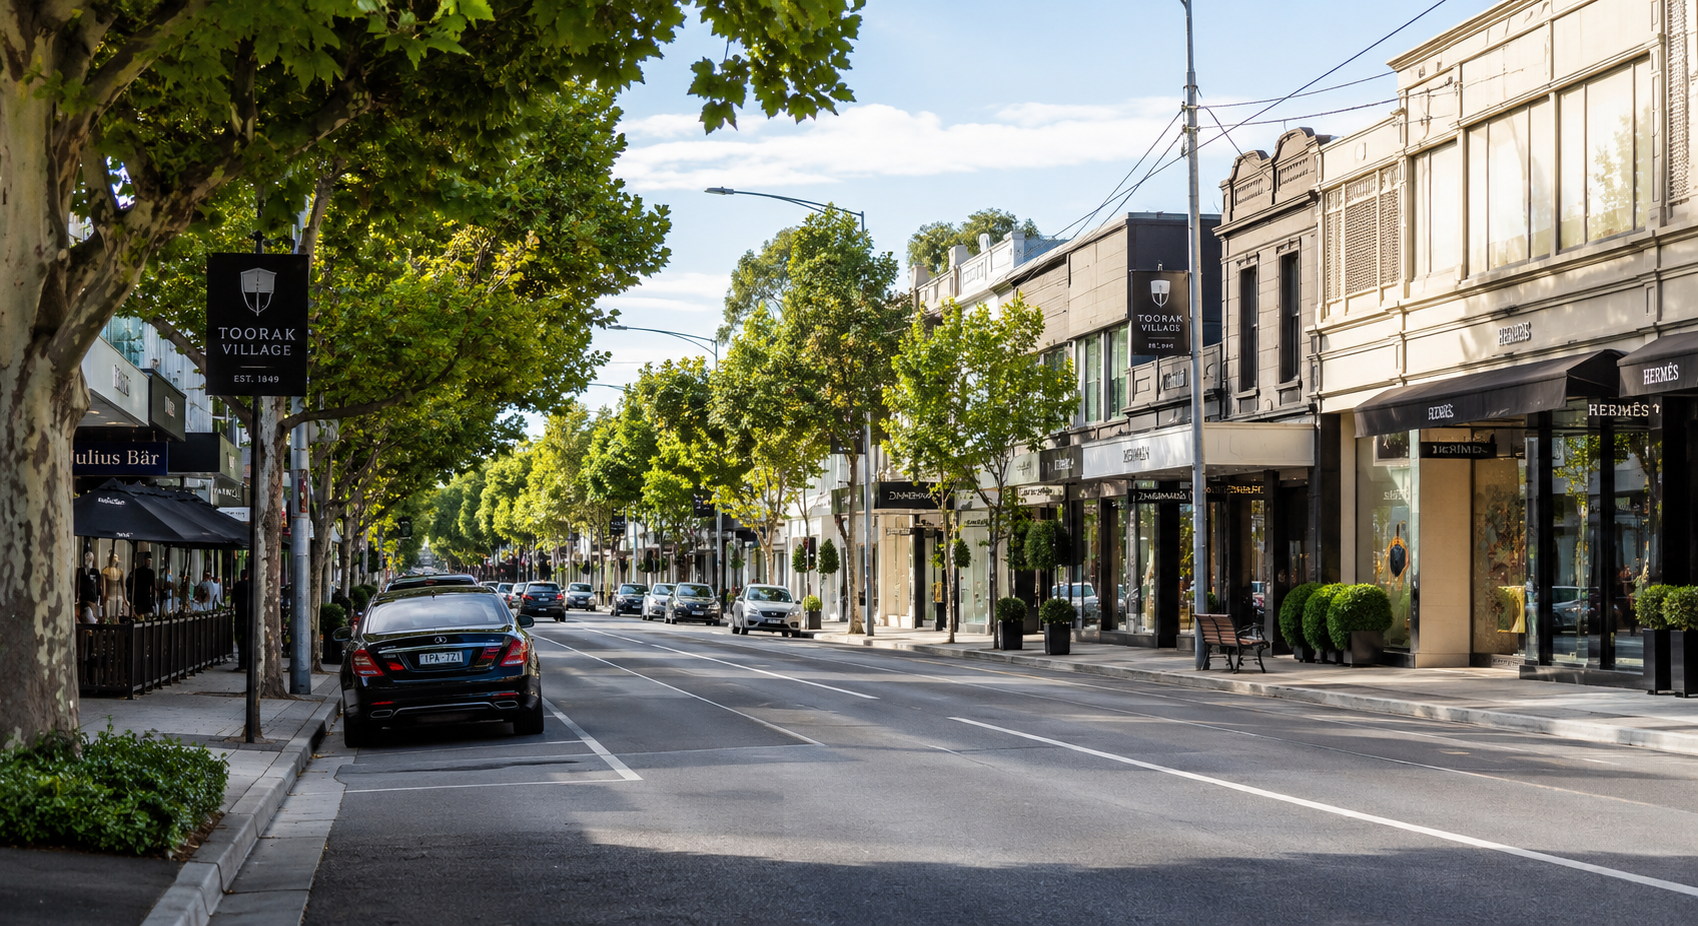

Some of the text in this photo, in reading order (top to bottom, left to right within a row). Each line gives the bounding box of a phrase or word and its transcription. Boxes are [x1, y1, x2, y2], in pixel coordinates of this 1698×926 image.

[1137, 314, 1183, 323] TOORAK
[218, 326, 296, 341] TOORAK
[222, 343, 292, 356] VILLAGE
[233, 374, 279, 383] EST. 1849
[126, 450, 160, 465] Bär
